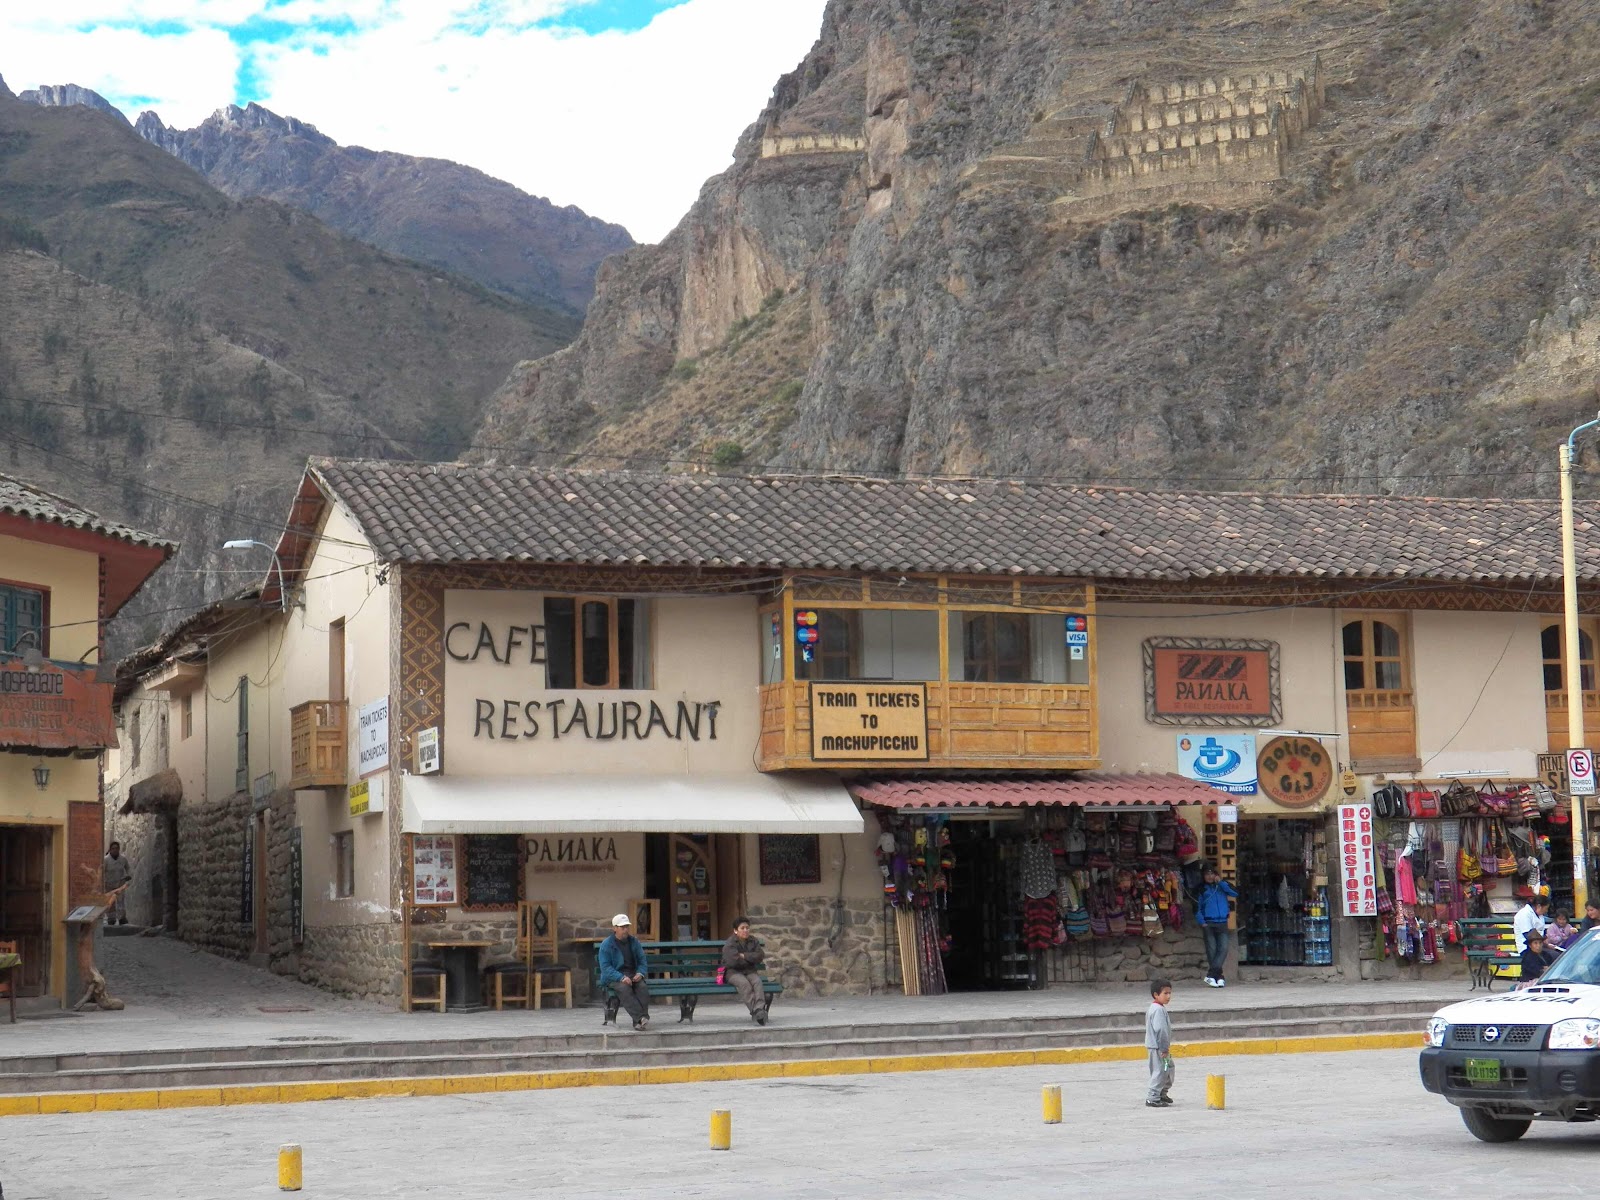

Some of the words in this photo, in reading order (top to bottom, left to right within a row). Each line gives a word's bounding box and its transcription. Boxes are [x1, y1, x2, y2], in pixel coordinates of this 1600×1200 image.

[446, 621, 547, 665] CAFE
[817, 692, 857, 708] TRAIN
[866, 692, 920, 708] TICKETS
[360, 713, 372, 729] TRAIN
[372, 706, 388, 723] TICKETS
[473, 698, 720, 742] RESTAURANT
[860, 714, 878, 729] TO
[371, 729, 377, 743] TO
[821, 735, 919, 751] MACHUPICCHU
[360, 742, 388, 764] MACHUPICCHU
[1540, 756, 1563, 772] MINI
[1229, 785, 1254, 793] MEDICO
[1342, 807, 1359, 914] DRUGSTORE
[1360, 821, 1375, 901] BOTICA
[1364, 901, 1375, 910] 24
